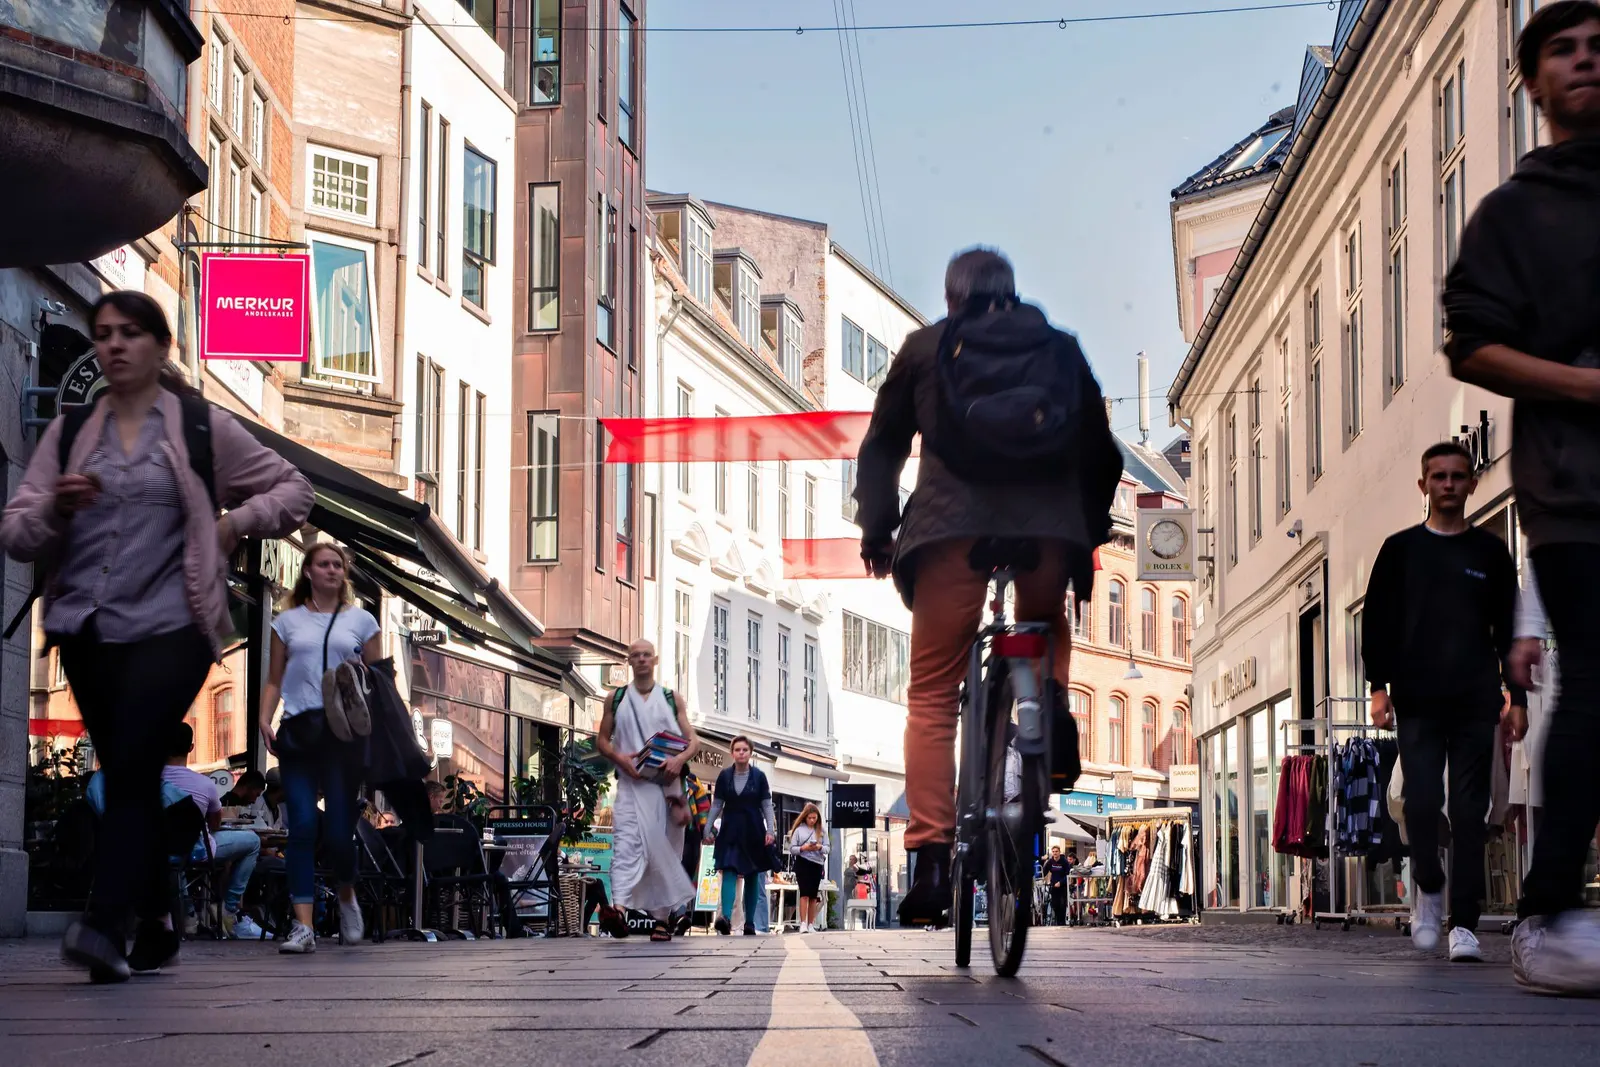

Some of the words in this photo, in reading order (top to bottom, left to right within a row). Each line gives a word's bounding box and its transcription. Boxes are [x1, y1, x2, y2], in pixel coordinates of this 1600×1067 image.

[216, 296, 294, 311] MERKUR
[245, 310, 294, 318] ANDELSKASSE
[412, 632, 440, 642] Normal
